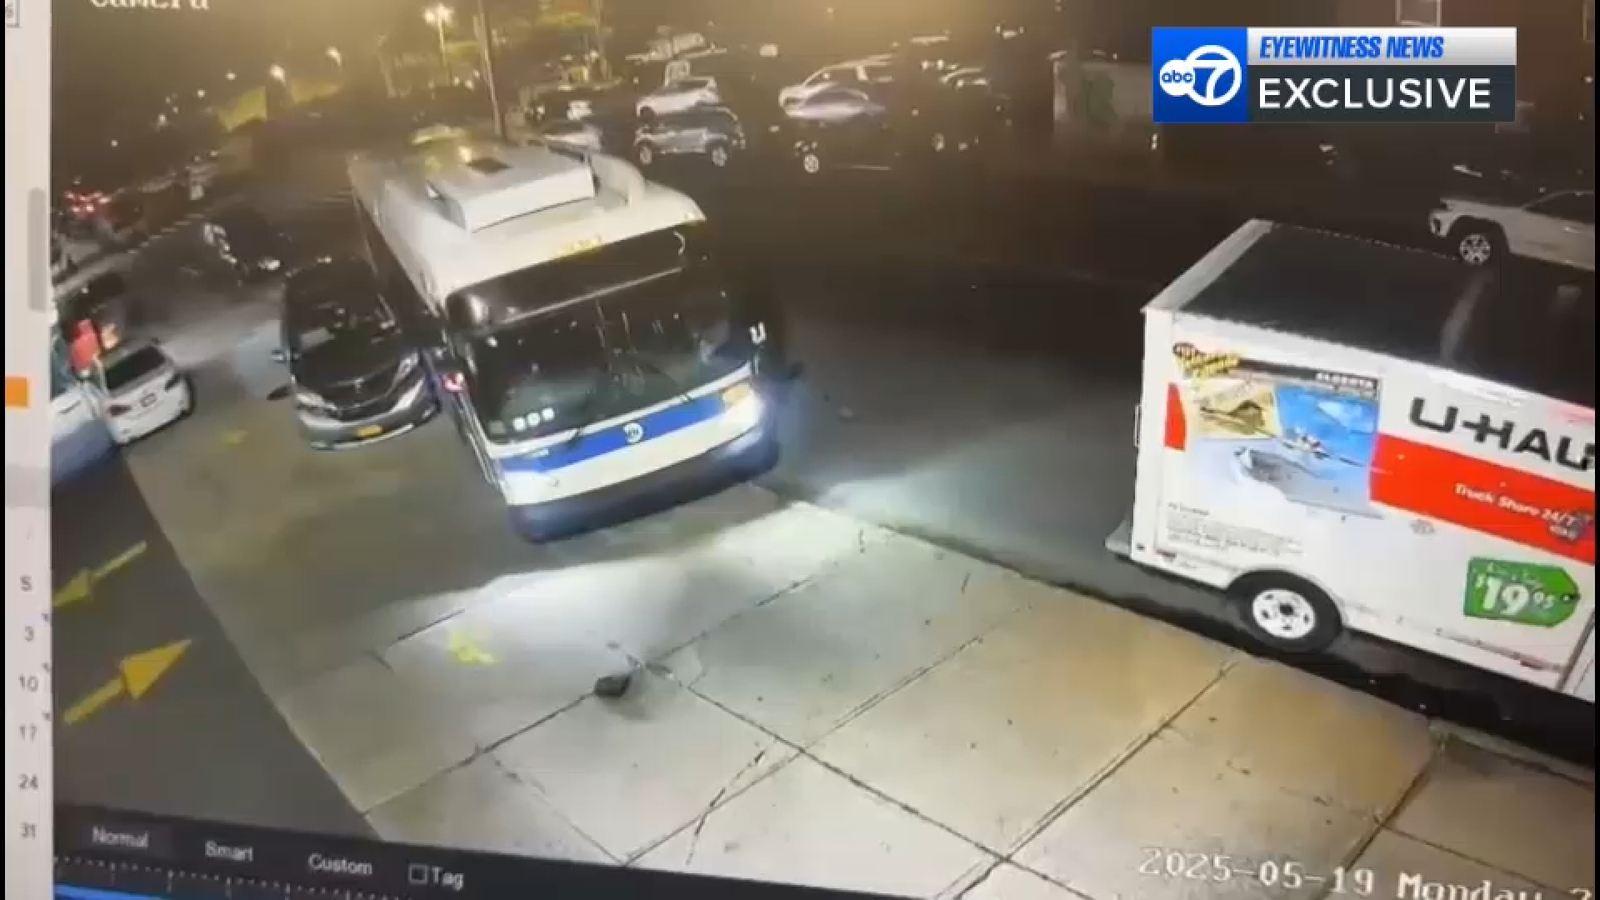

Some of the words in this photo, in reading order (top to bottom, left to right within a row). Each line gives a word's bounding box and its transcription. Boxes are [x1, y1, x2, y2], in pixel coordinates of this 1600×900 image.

[24, 625, 36, 642] 3
[18, 674, 39, 692] 10
[18, 723, 38, 742] 17
[18, 772, 39, 790] 24
[20, 821, 38, 840] 31
[92, 826, 149, 848] Normal
[204, 839, 254, 862] Smart
[308, 852, 373, 876] Custom
[1138, 846, 1375, 896] 2025-05-19
[431, 866, 465, 892] Tag
